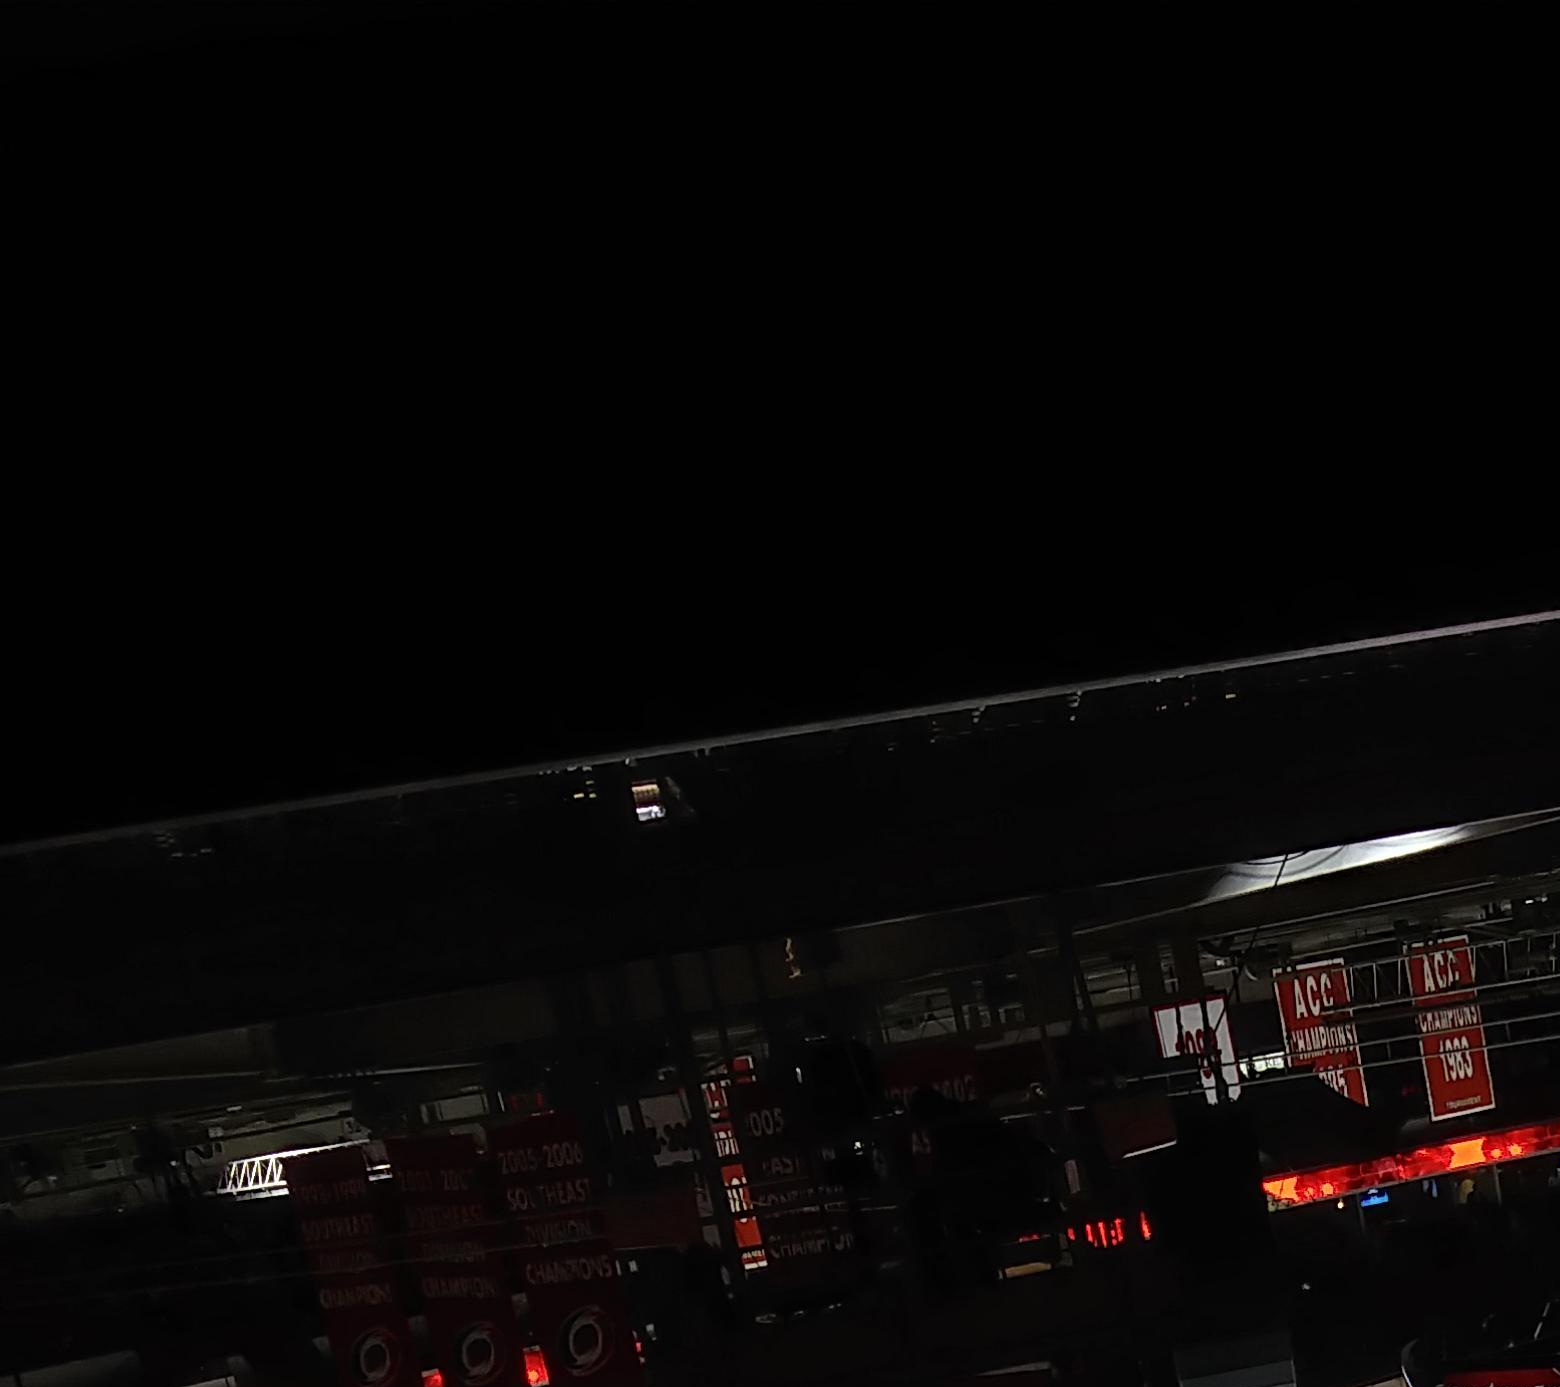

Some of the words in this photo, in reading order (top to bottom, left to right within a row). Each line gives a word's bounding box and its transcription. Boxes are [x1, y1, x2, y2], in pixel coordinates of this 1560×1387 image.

[1423, 950, 1460, 993] ACC
[1293, 973, 1334, 1020] ACC
[1416, 1005, 1479, 1033] CHAMPIONS
[1439, 1035, 1473, 1083] 1983
